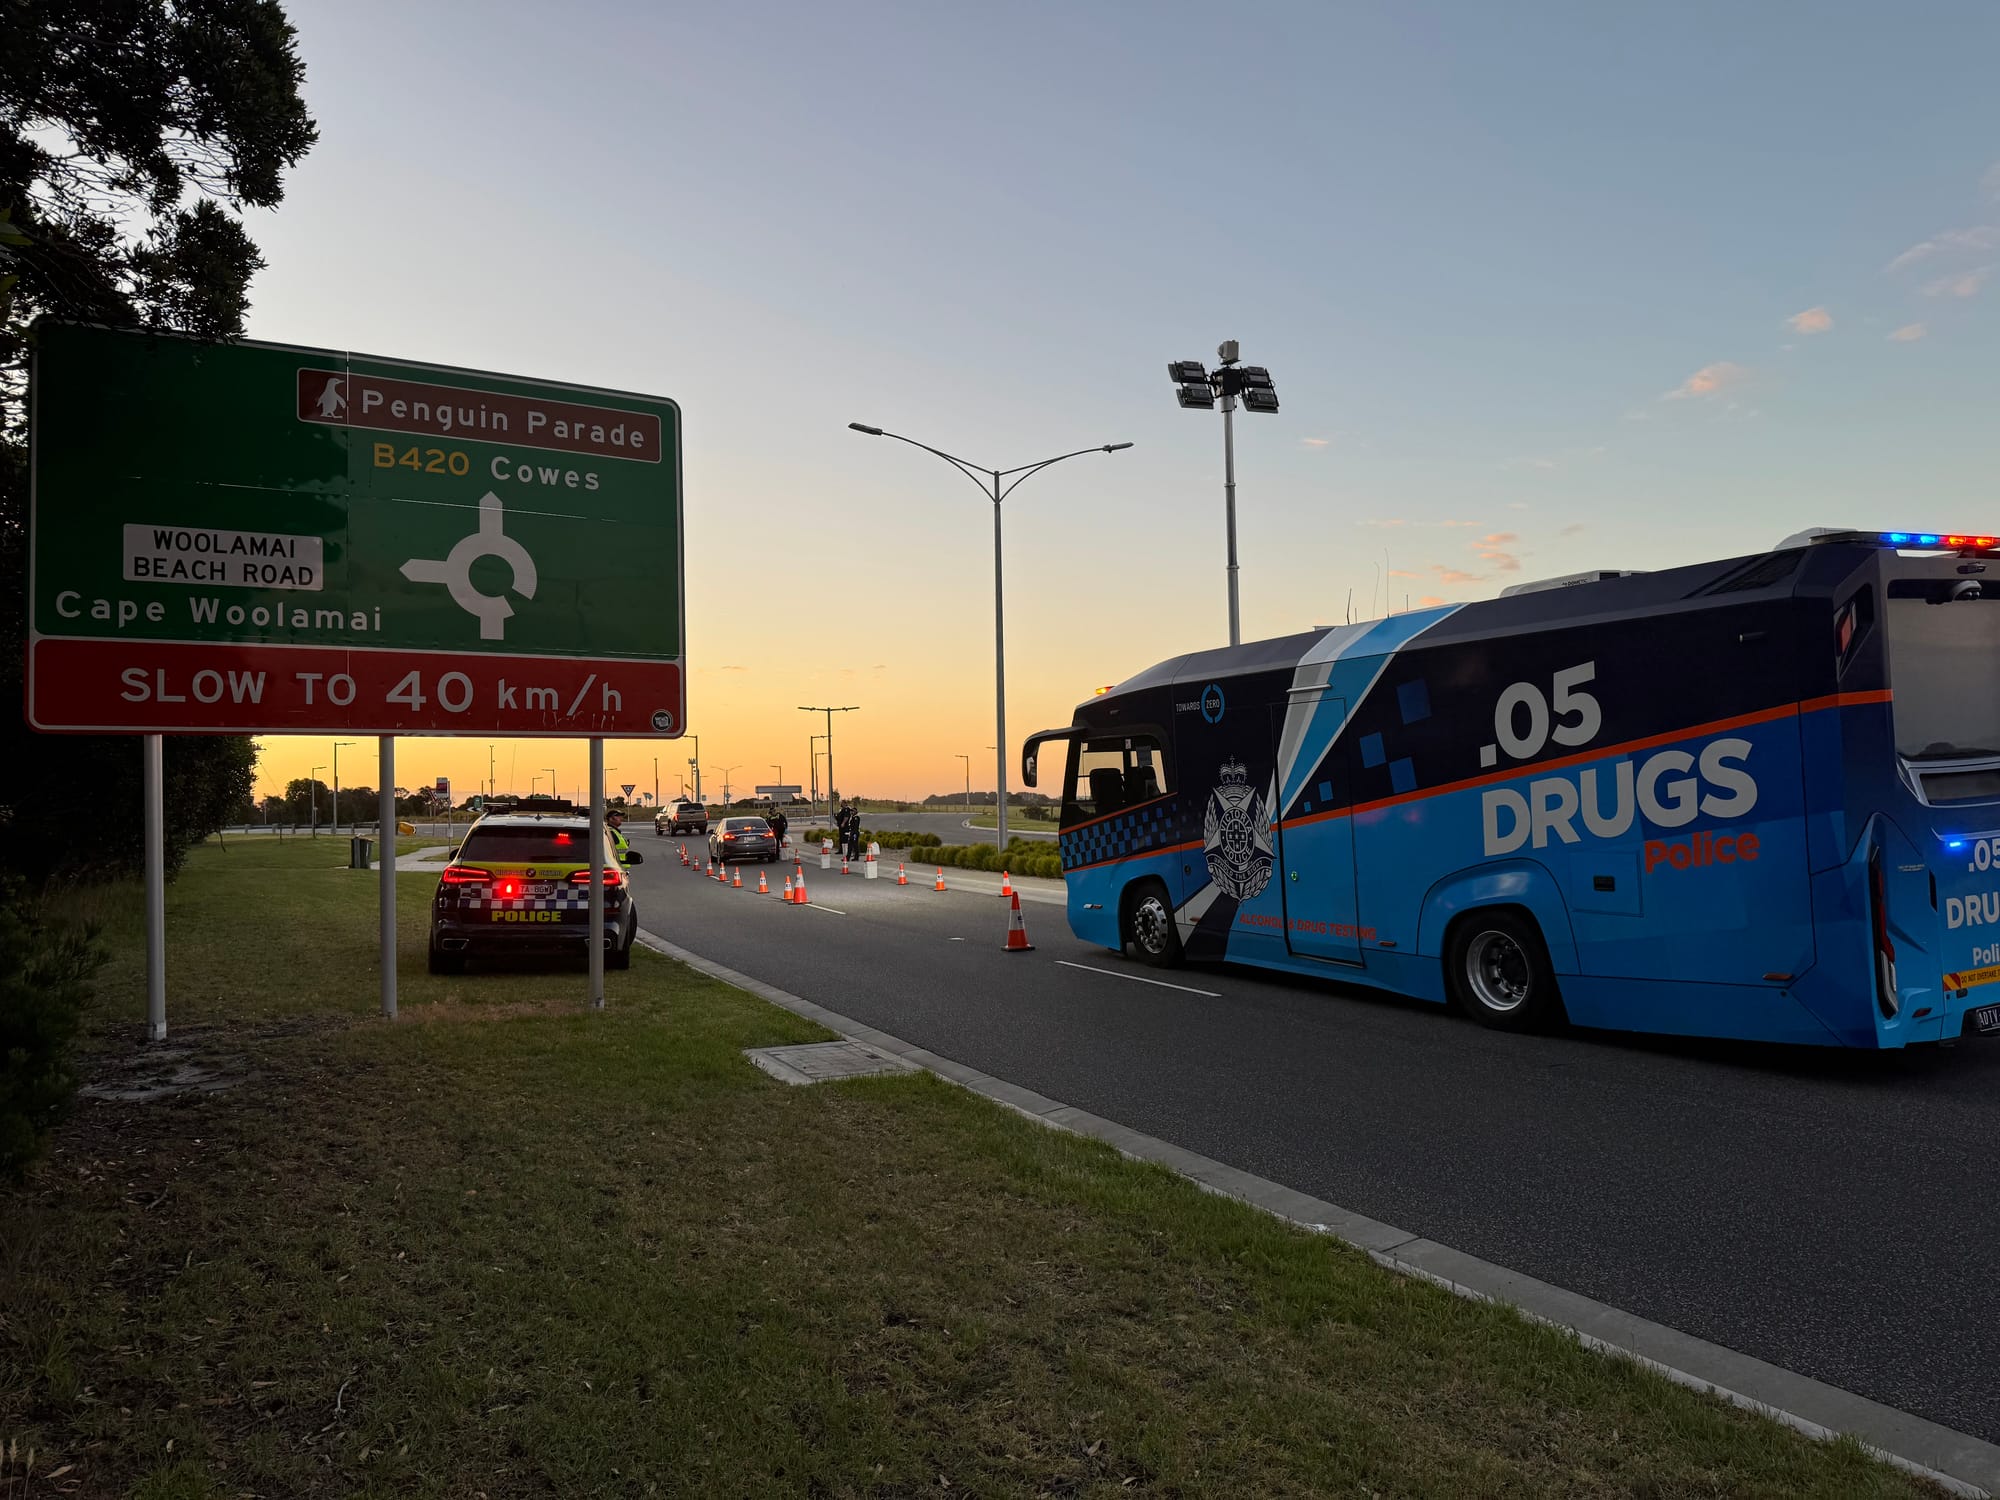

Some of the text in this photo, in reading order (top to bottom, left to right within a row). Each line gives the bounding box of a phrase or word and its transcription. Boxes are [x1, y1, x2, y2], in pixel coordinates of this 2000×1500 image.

[362, 389, 645, 448] Penguin Parade
[373, 443, 470, 476] B420
[490, 456, 600, 490] Cowes
[153, 530, 296, 559] WOOLAMAI
[134, 556, 314, 586] BEACH ROAD
[55, 591, 382, 632] Cape Woolamai
[120, 668, 623, 717] SLOW TO 40 km/h
[1176, 699, 1220, 712] TOWARDS ZERO
[1479, 660, 1602, 768] .05
[1482, 738, 1758, 857] DRUGS
[1221, 809, 1253, 834] VICTORIA
[1224, 845, 1252, 863] POLICE
[1644, 830, 1761, 875] Police
[491, 911, 561, 922] POLICE
[1240, 913, 1284, 929] ALCOHOL
[1297, 919, 1326, 934] DRUG
[1329, 923, 1377, 941] TESTING
